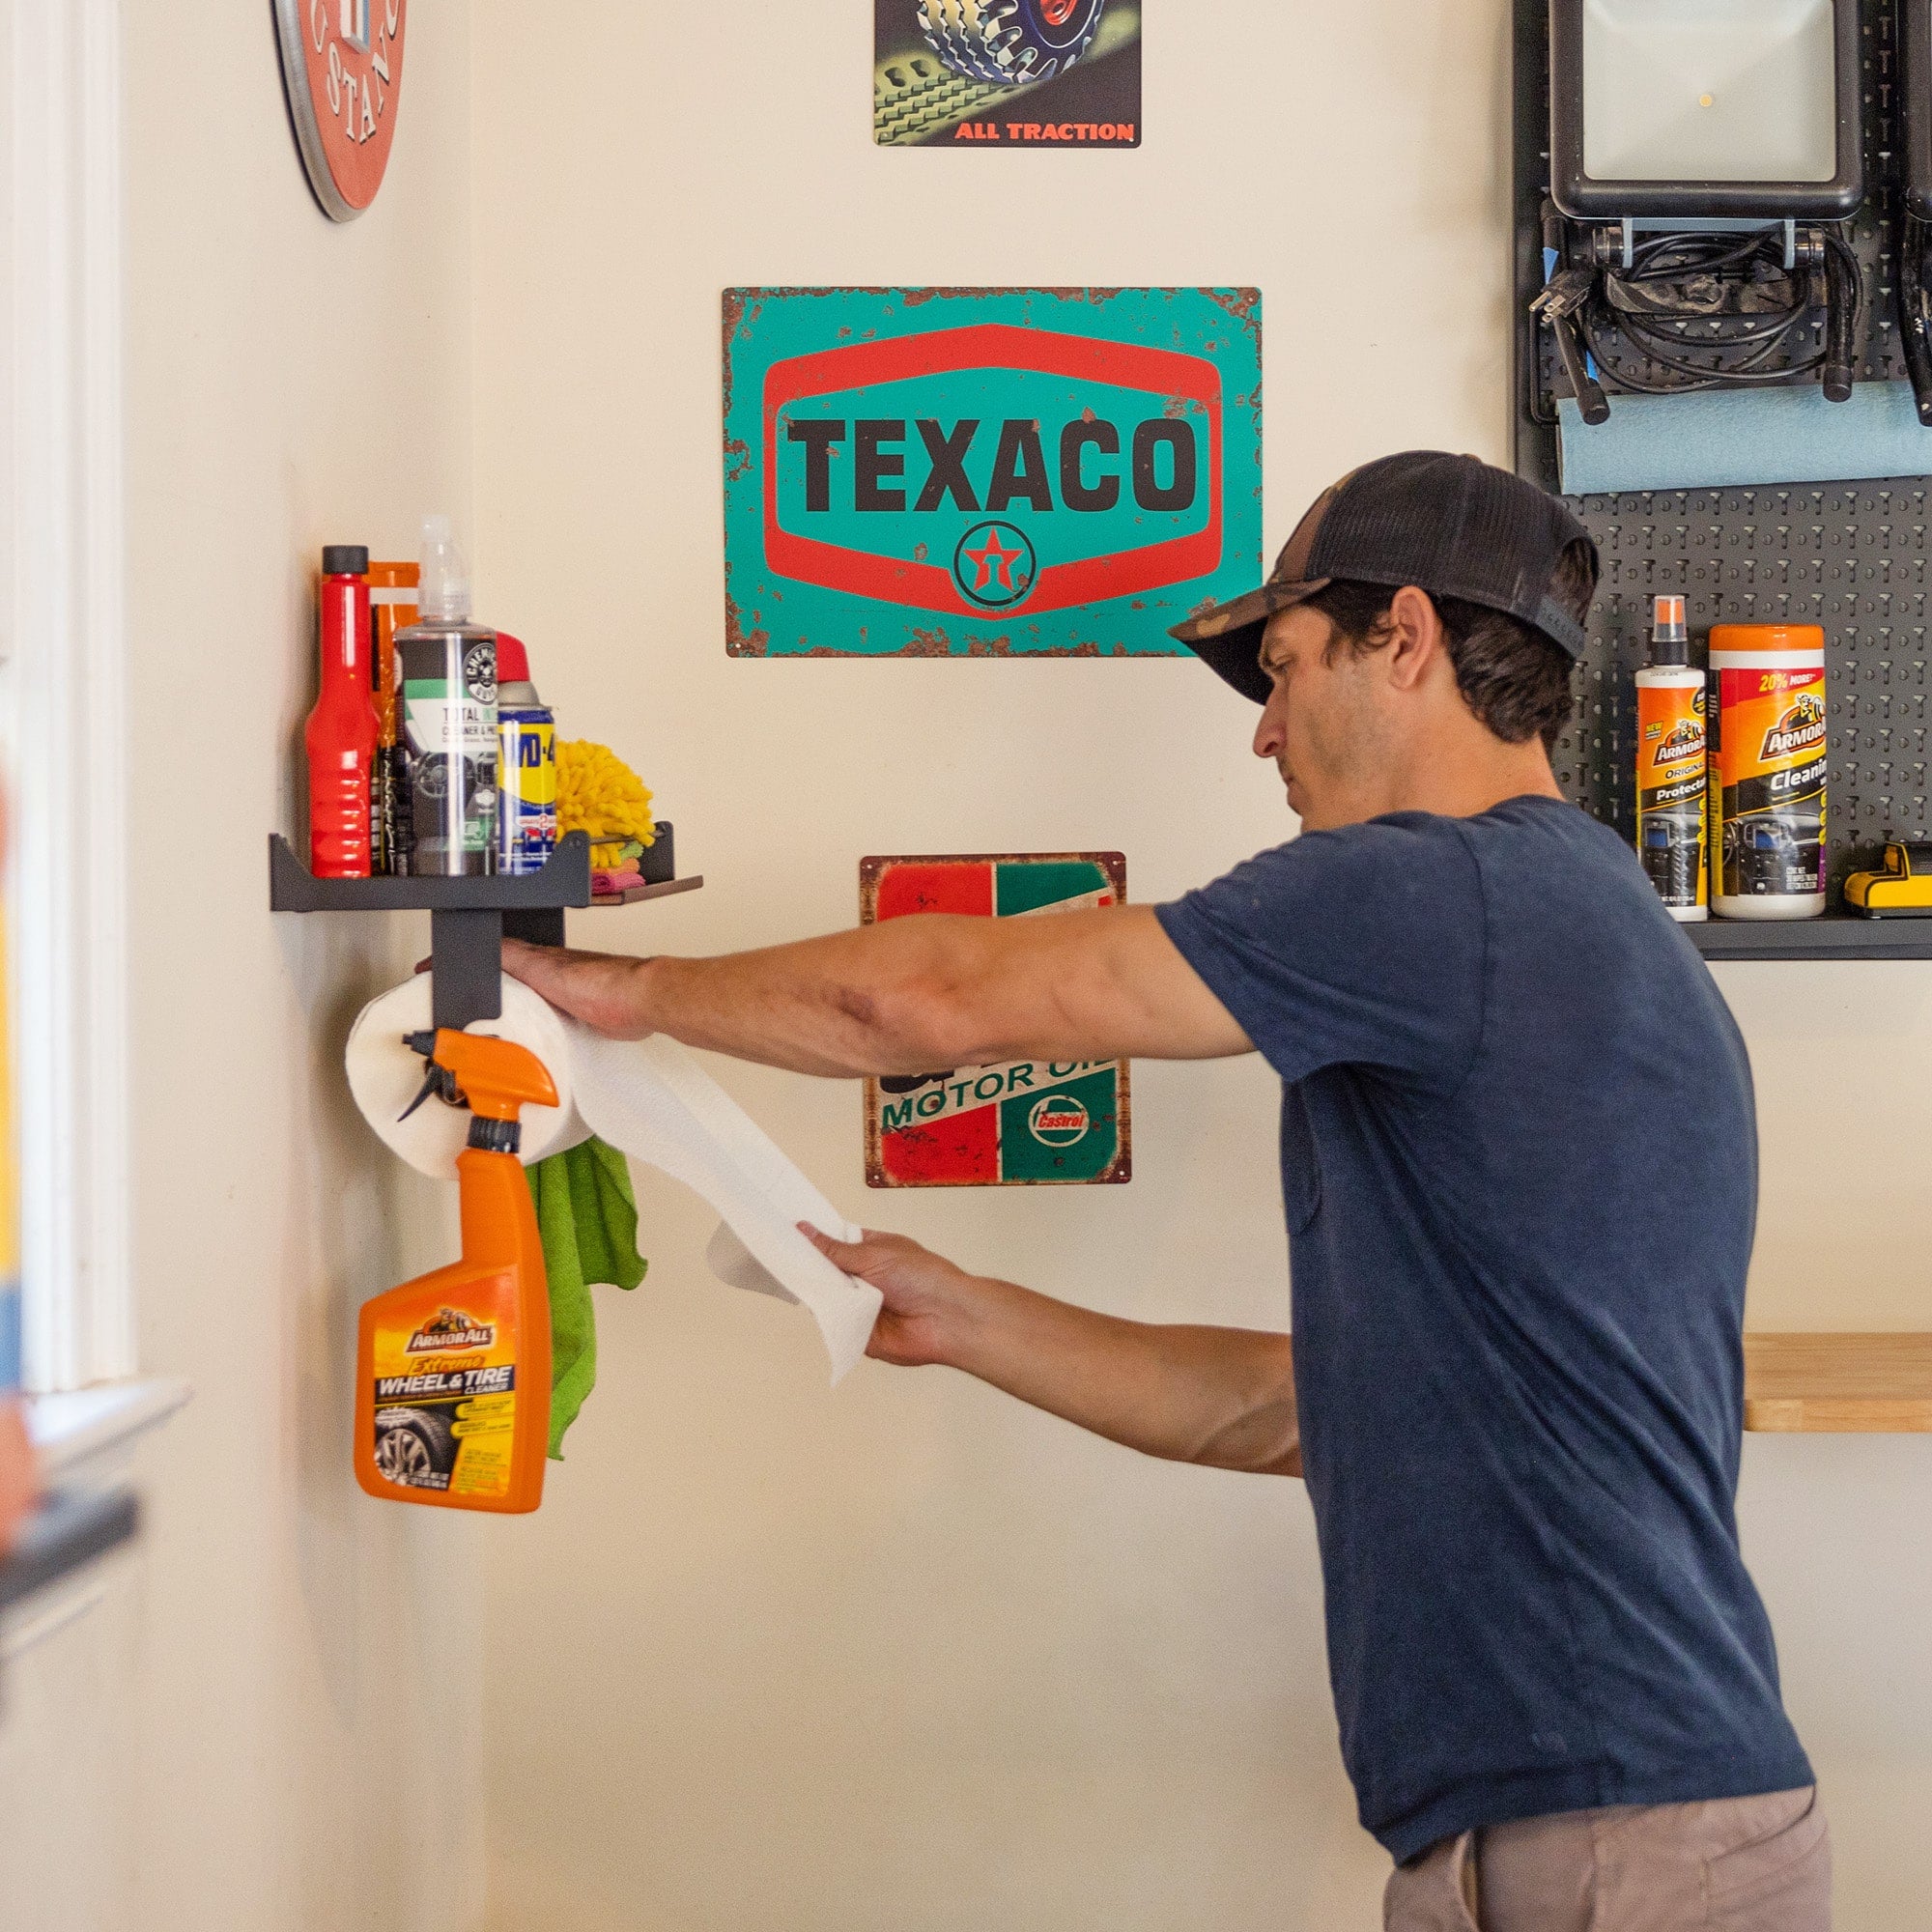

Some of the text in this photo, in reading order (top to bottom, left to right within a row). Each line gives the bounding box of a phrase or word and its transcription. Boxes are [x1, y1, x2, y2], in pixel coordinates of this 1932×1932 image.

[955, 122, 1134, 141] ALL TRACTION
[786, 417, 1197, 512] TEXACO
[1758, 673, 1789, 692] 20%
[442, 708, 480, 722] TTAL
[1767, 717, 1826, 753] ARMORA
[1657, 736, 1706, 761] ARMORA
[882, 1062, 1035, 1127] MOTOR
[1038, 1114, 1085, 1128] Castrol
[379, 1366, 513, 1395] WHEEL & TIRE
[464, 1382, 509, 1395] CLEANER
